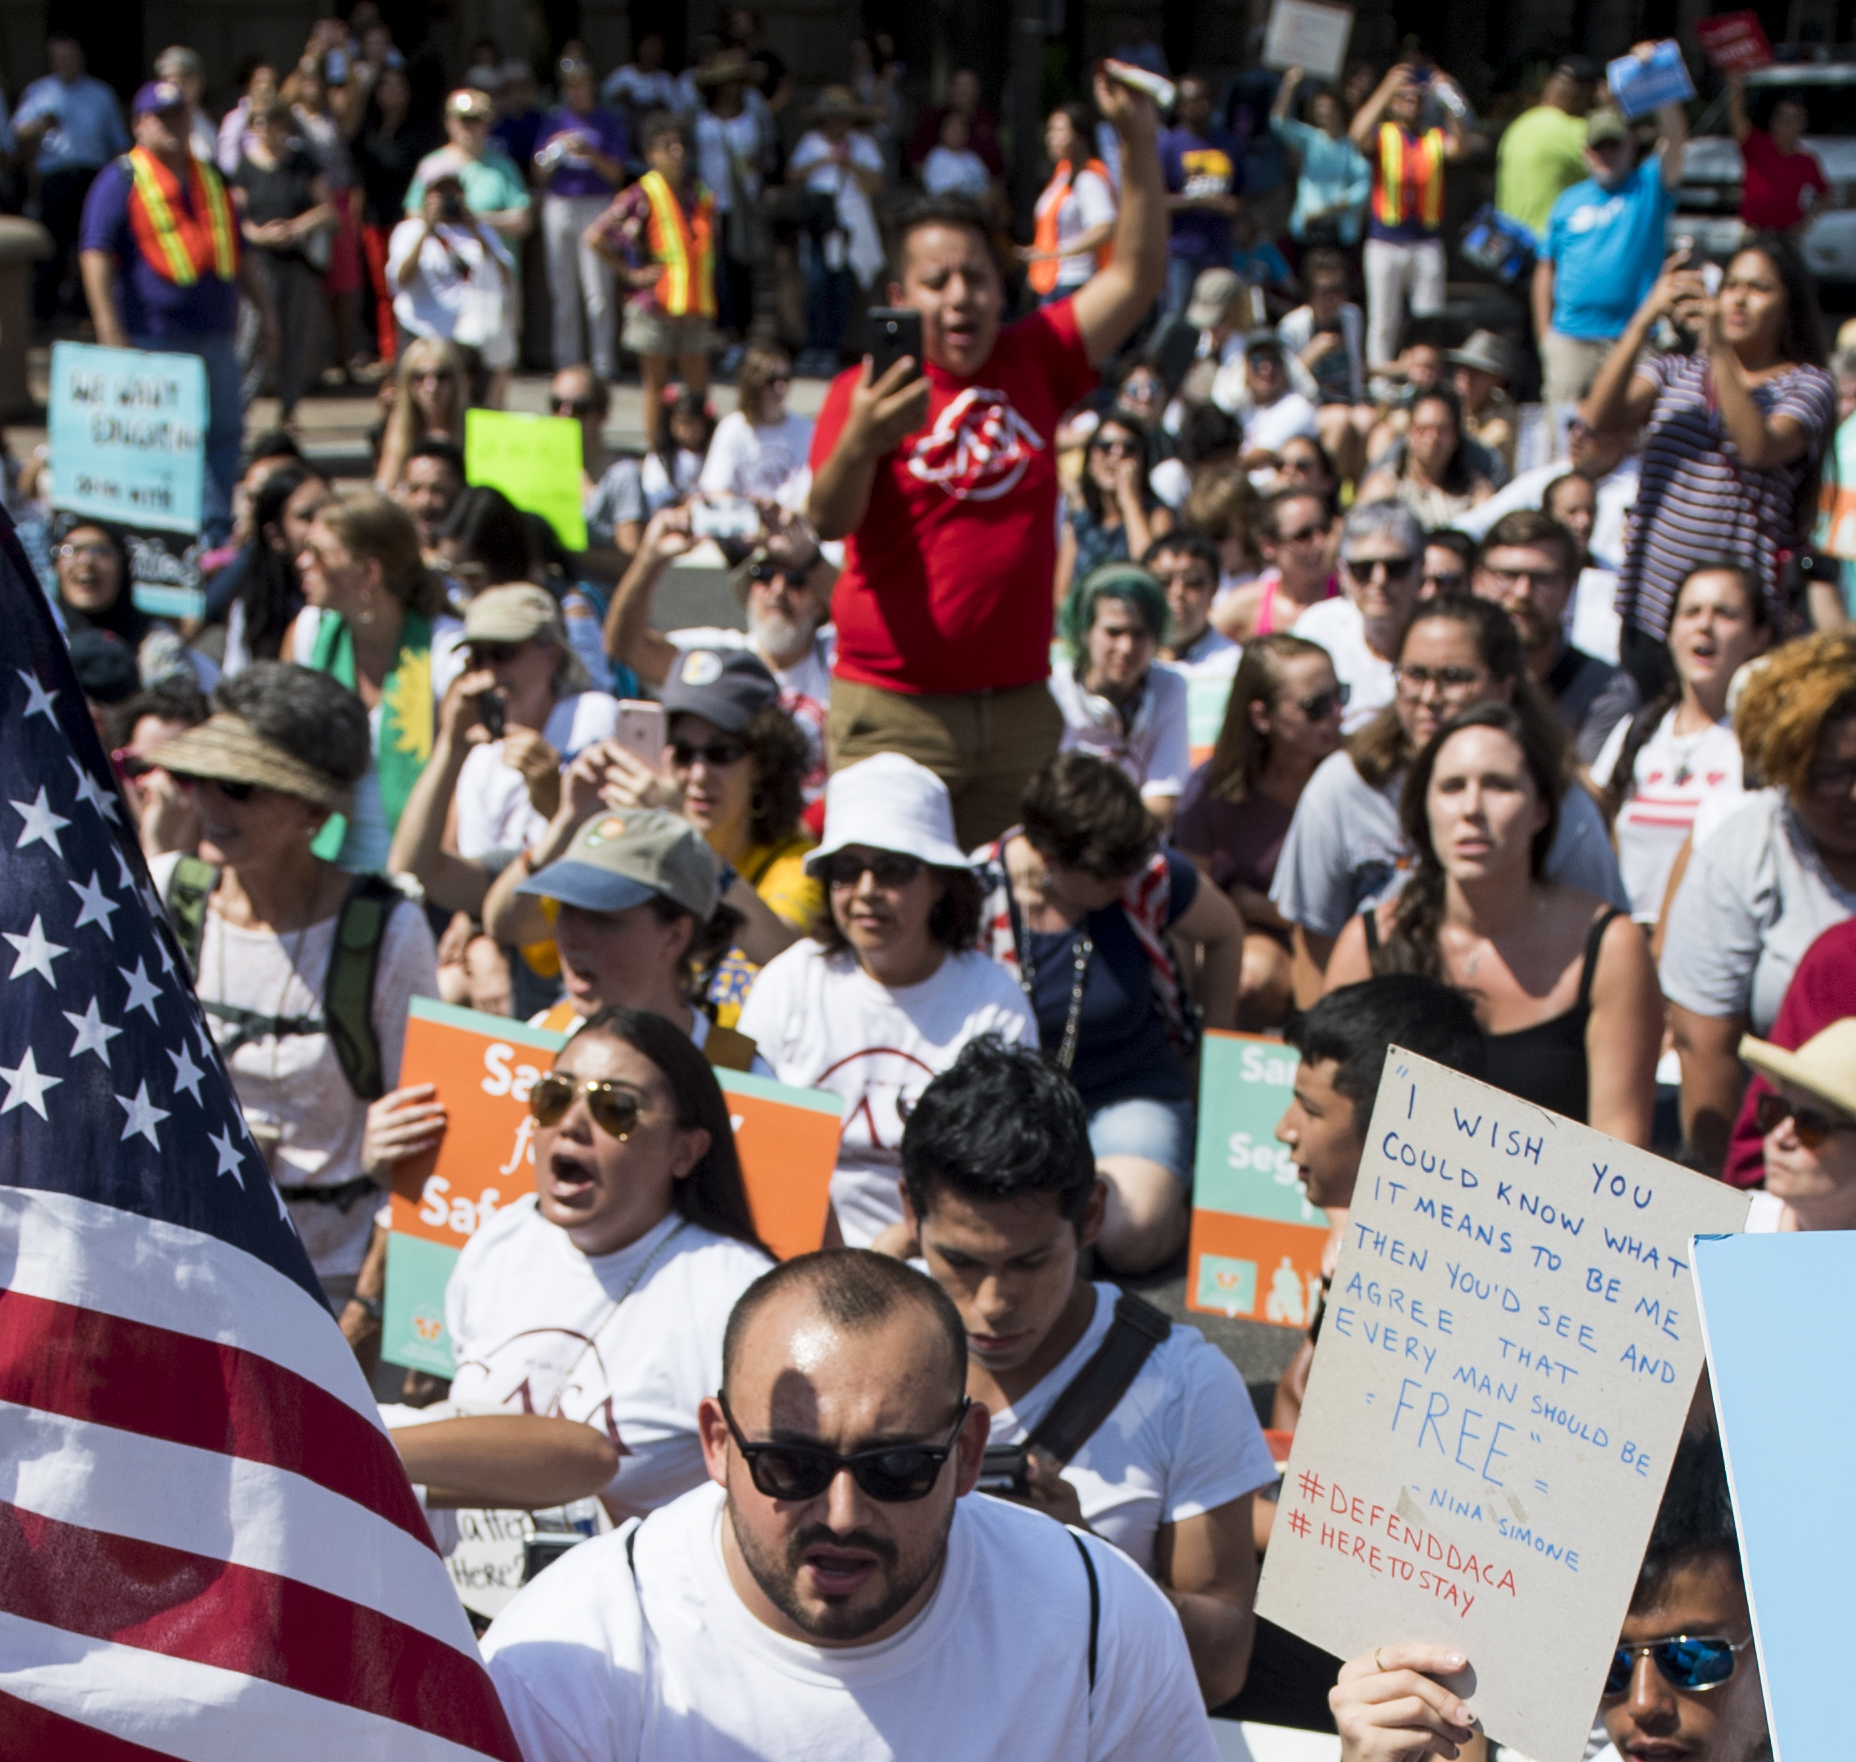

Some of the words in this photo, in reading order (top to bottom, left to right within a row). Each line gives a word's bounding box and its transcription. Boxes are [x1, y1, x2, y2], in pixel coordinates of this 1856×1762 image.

[1382, 1131, 1479, 1189] COULD
[1498, 1181, 1585, 1237] KNOW
[1604, 1227, 1691, 1279] WHAT
[1454, 1106, 1544, 1166] WISH
[1592, 1162, 1653, 1209] YOU
[1345, 1271, 1454, 1335] AGREE
[1498, 1337, 1579, 1385] THAT
[1354, 1221, 1429, 1273] THEN
[1446, 1261, 1521, 1314] YOU'D
[1538, 1306, 1598, 1354] SEE
[1620, 1344, 1676, 1385] AND
[1374, 1176, 1407, 1205] IT
[1414, 1198, 1513, 1254] MEANS
[1531, 1246, 1563, 1273] TO
[1586, 1266, 1623, 1304] BE
[1635, 1296, 1681, 1342] ME
[1335, 1307, 1437, 1375] EVERY
[1453, 1365, 1518, 1405] MAN
[1531, 1394, 1610, 1449] SHOULD
[1620, 1441, 1652, 1477] BE
[1298, 1468, 1517, 1598] #DEFENDDACA
[1499, 1518, 1580, 1573] SIMONE
